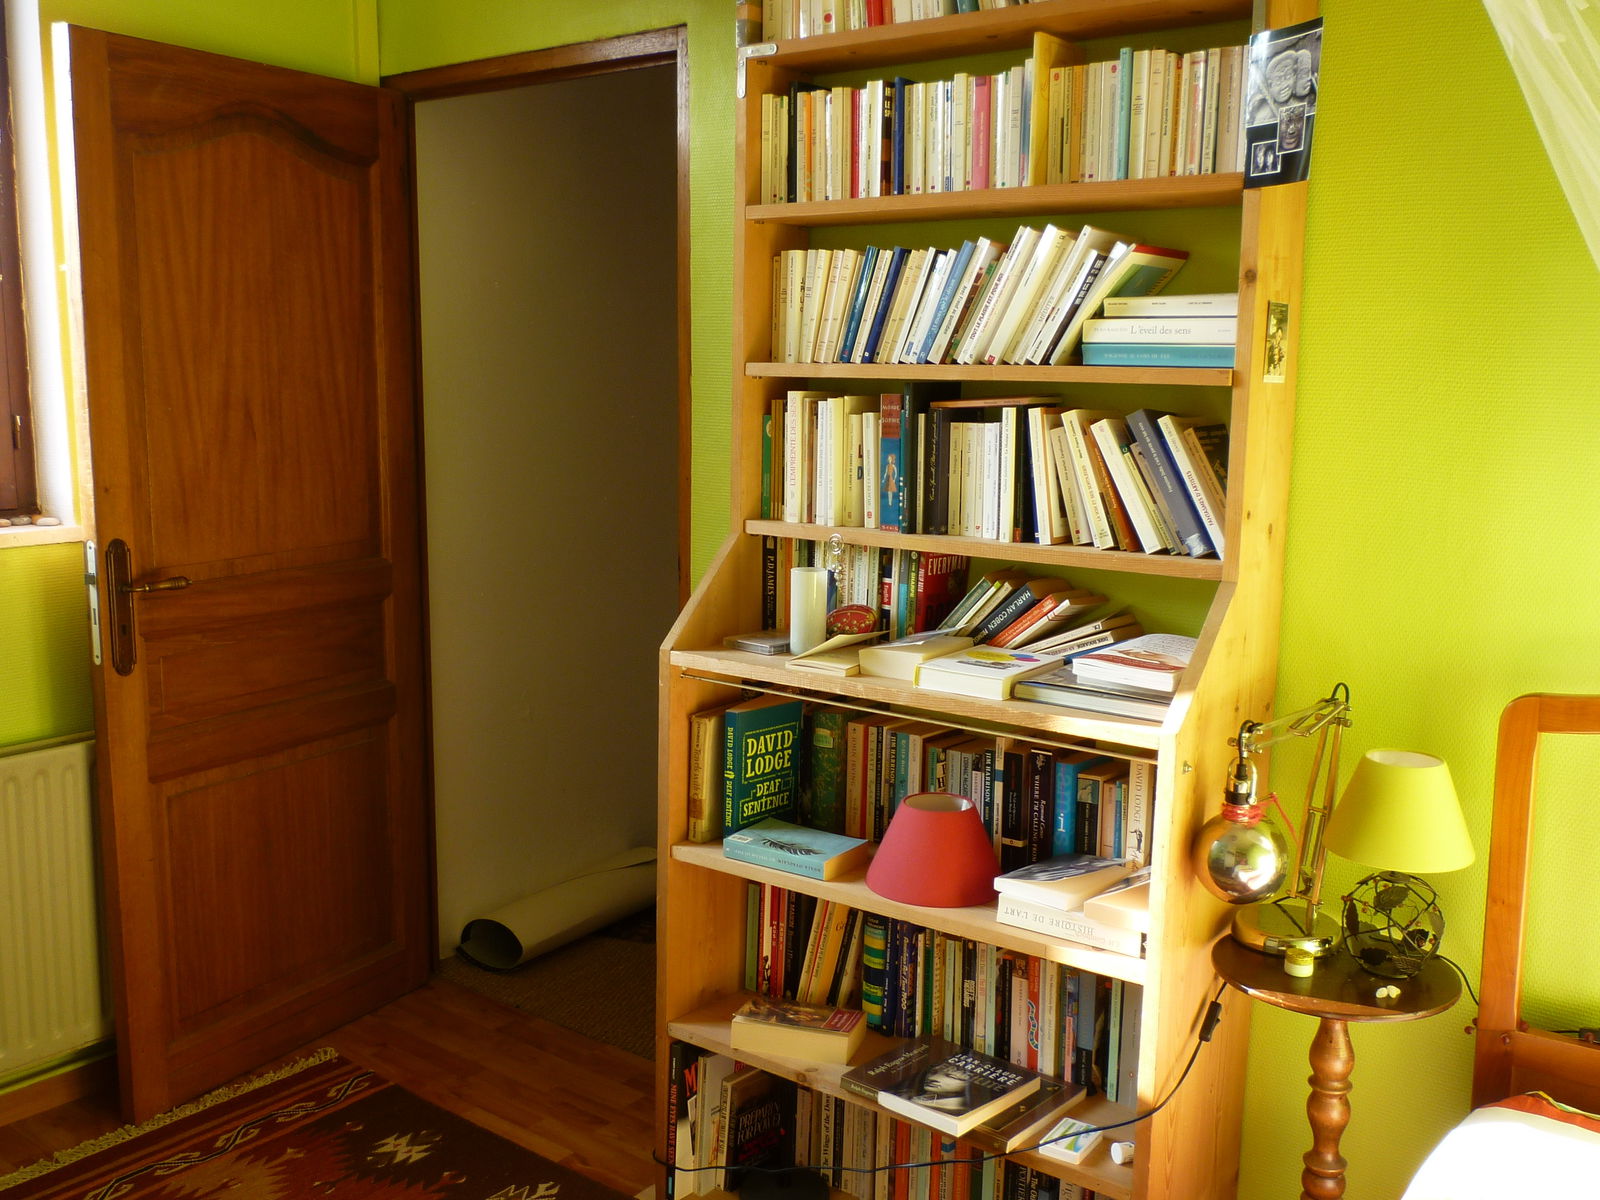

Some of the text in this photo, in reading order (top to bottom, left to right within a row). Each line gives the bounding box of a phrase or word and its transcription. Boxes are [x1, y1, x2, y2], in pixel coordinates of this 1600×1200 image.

[1130, 325, 1157, 334] L'éveil
[1159, 325, 1172, 334] des
[927, 555, 968, 576] EVERYMAN
[1003, 589, 1033, 614] HARLAN
[985, 609, 1009, 629] COBEN
[746, 729, 793, 757] DAVID
[745, 750, 792, 778] LODGE
[756, 778, 782, 796] DEAF
[1133, 763, 1143, 824] DAVID LODGE
[742, 791, 790, 817] SENTENCE
[1003, 906, 1095, 936] HISTOIRE DE L'ART
[948, 1057, 1018, 1087] CARRIÈRE
[955, 1054, 1023, 1081] JEAN-CLAUDE
[822, 1133, 831, 1155] Wings
